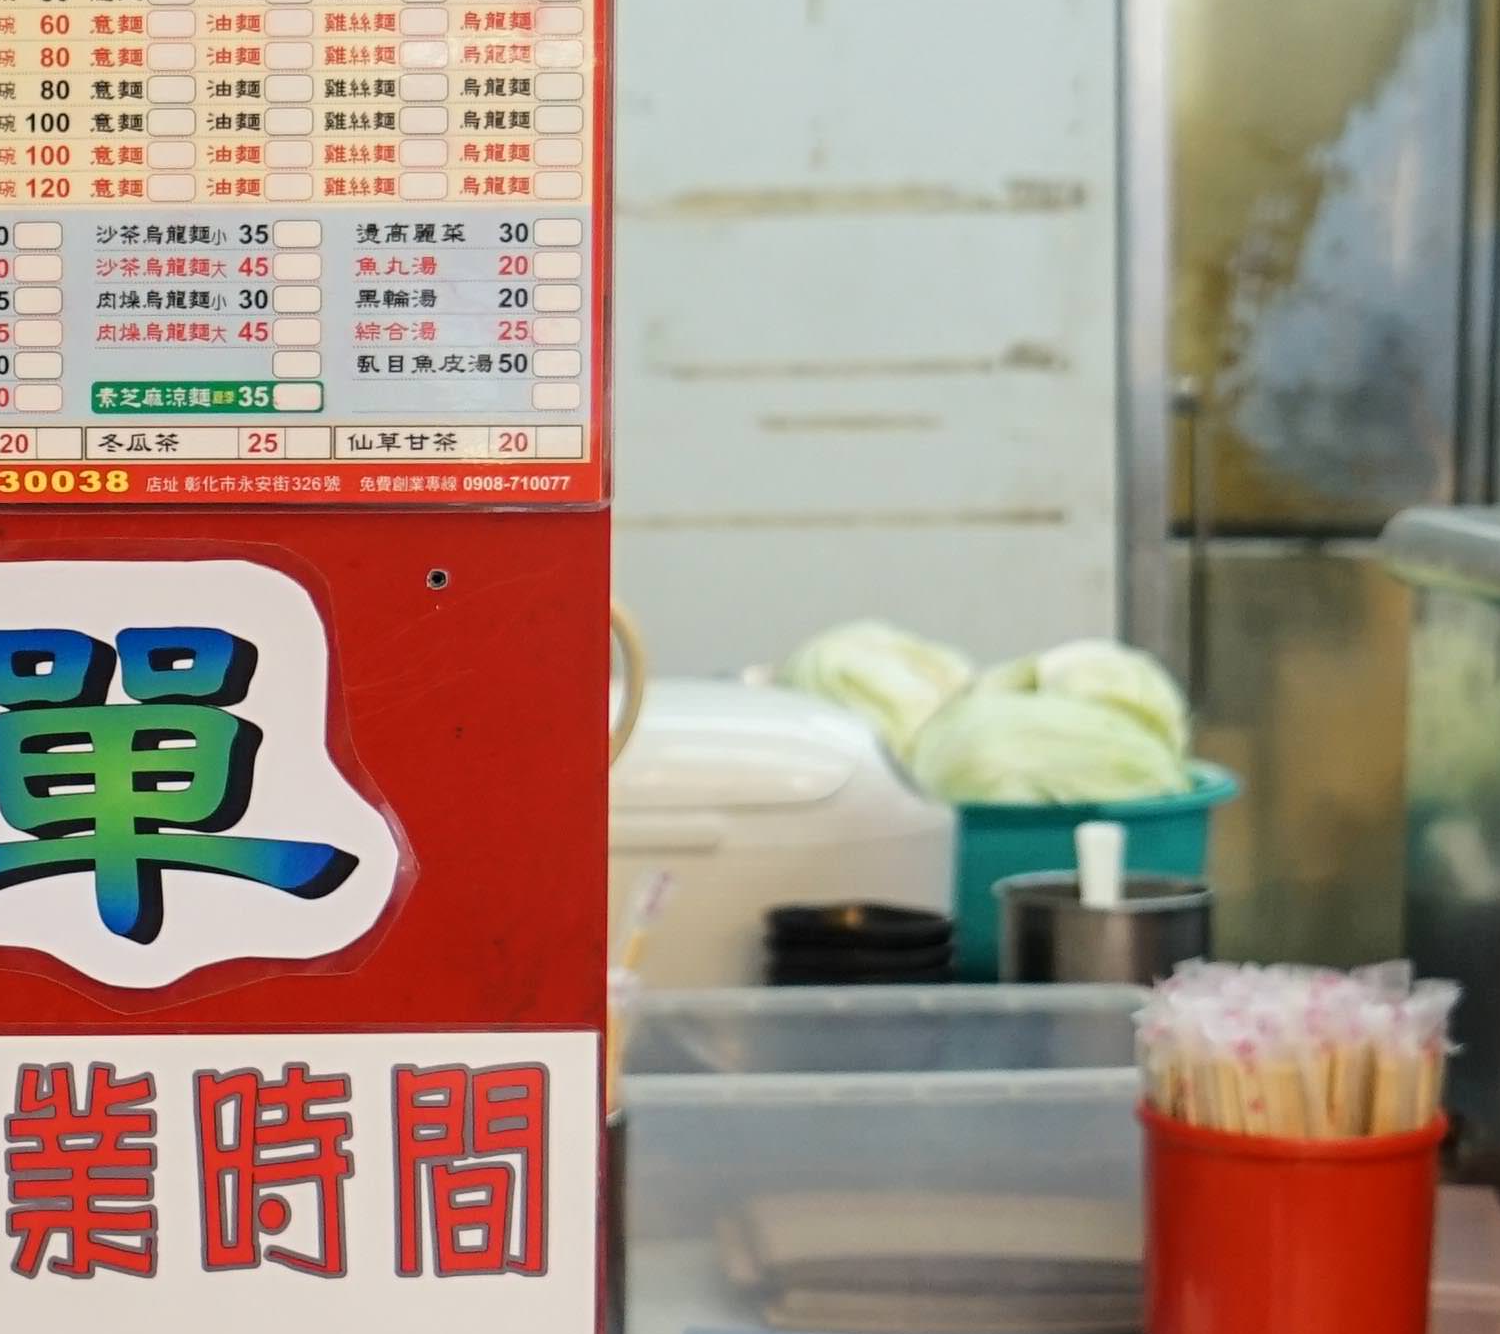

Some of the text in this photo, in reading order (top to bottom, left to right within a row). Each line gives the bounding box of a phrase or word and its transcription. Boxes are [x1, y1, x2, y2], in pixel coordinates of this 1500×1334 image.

[26, 113, 70, 133] 100
[26, 146, 70, 166] 100
[26, 179, 70, 199] 120
[96, 225, 268, 245] 沙茶烏龍麵小 35
[356, 223, 528, 244] 燙高麗菜 30
[96, 257, 268, 277] 沙茶烏龍麵大 45
[355, 256, 528, 277] 魚丸湯 20
[239, 289, 268, 309] 30
[356, 289, 528, 308] 黑輪湯 20
[238, 322, 268, 341] 45
[355, 321, 528, 341] 綜合湯 25
[500, 354, 528, 373] 50
[96, 387, 210, 407] 素芝麻涼麵
[238, 387, 269, 407] 35
[0, 435, 28, 453] 20
[98, 433, 278, 453] 冬瓜茶 25
[348, 433, 528, 452] 仙草甘茶 20
[146, 476, 178, 492] 店址
[184, 475, 340, 493] 彰化市永安街326號
[463, 476, 570, 491] 0908-710077
